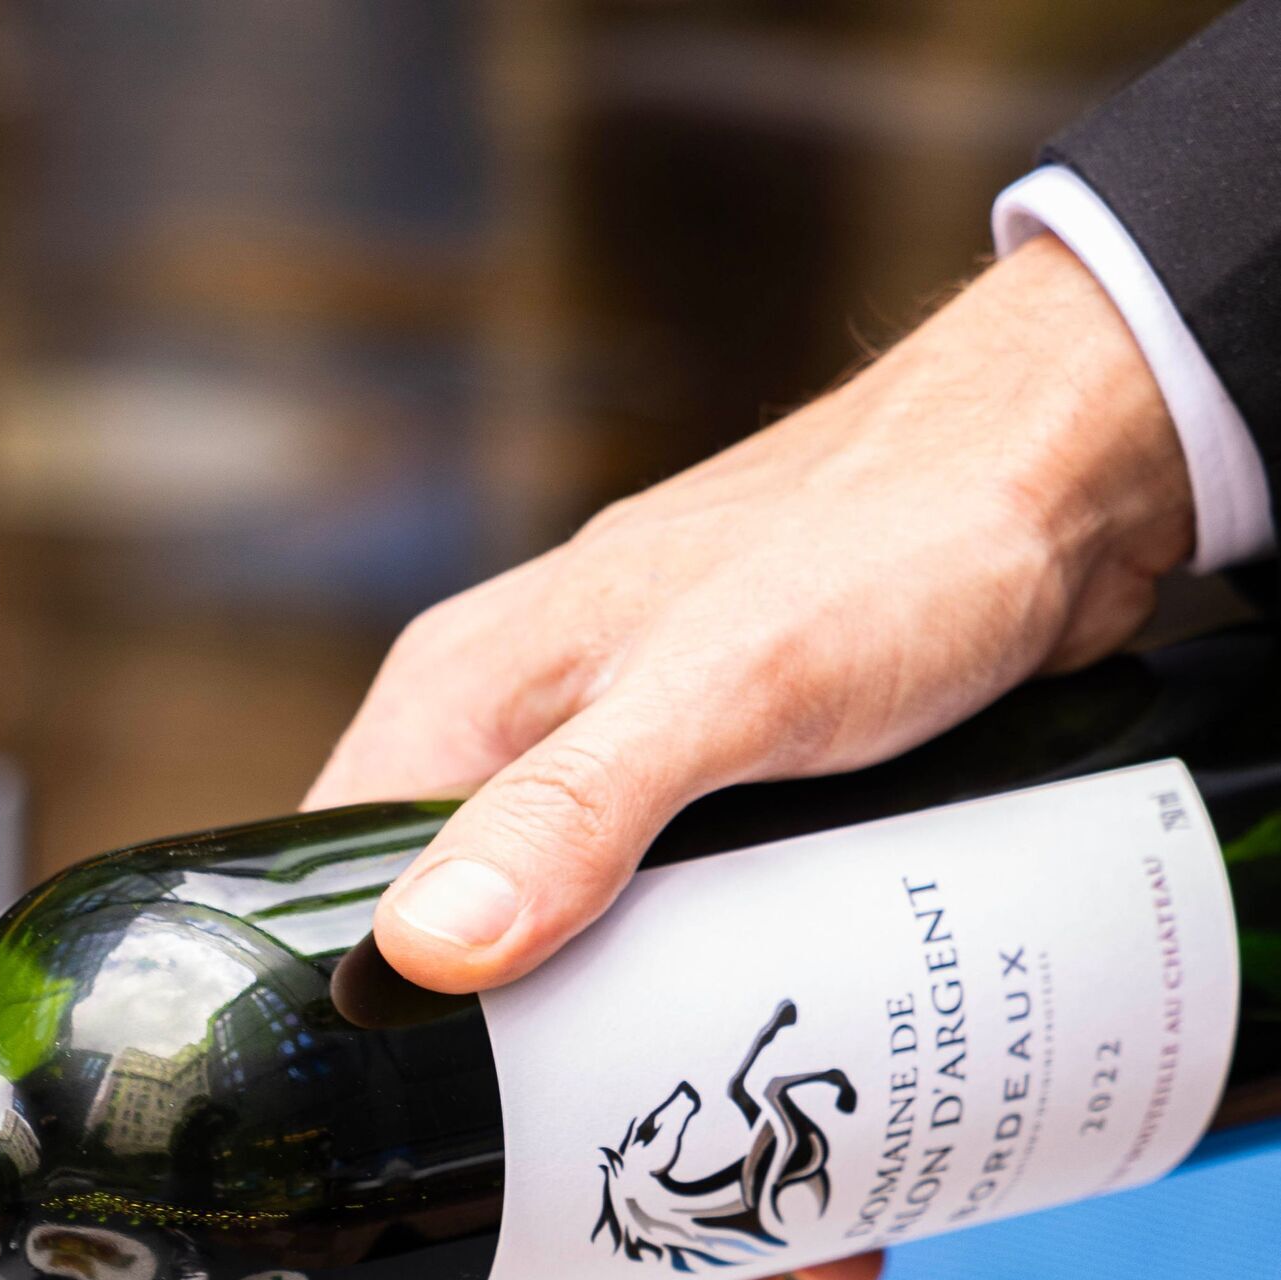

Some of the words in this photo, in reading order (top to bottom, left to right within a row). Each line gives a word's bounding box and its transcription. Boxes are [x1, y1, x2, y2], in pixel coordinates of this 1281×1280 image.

[844, 1066, 918, 1239] DOMAINE
[887, 992, 918, 1058] DE
[902, 876, 967, 1130] D'ARGENT
[1079, 1038, 1122, 1136] 2022
